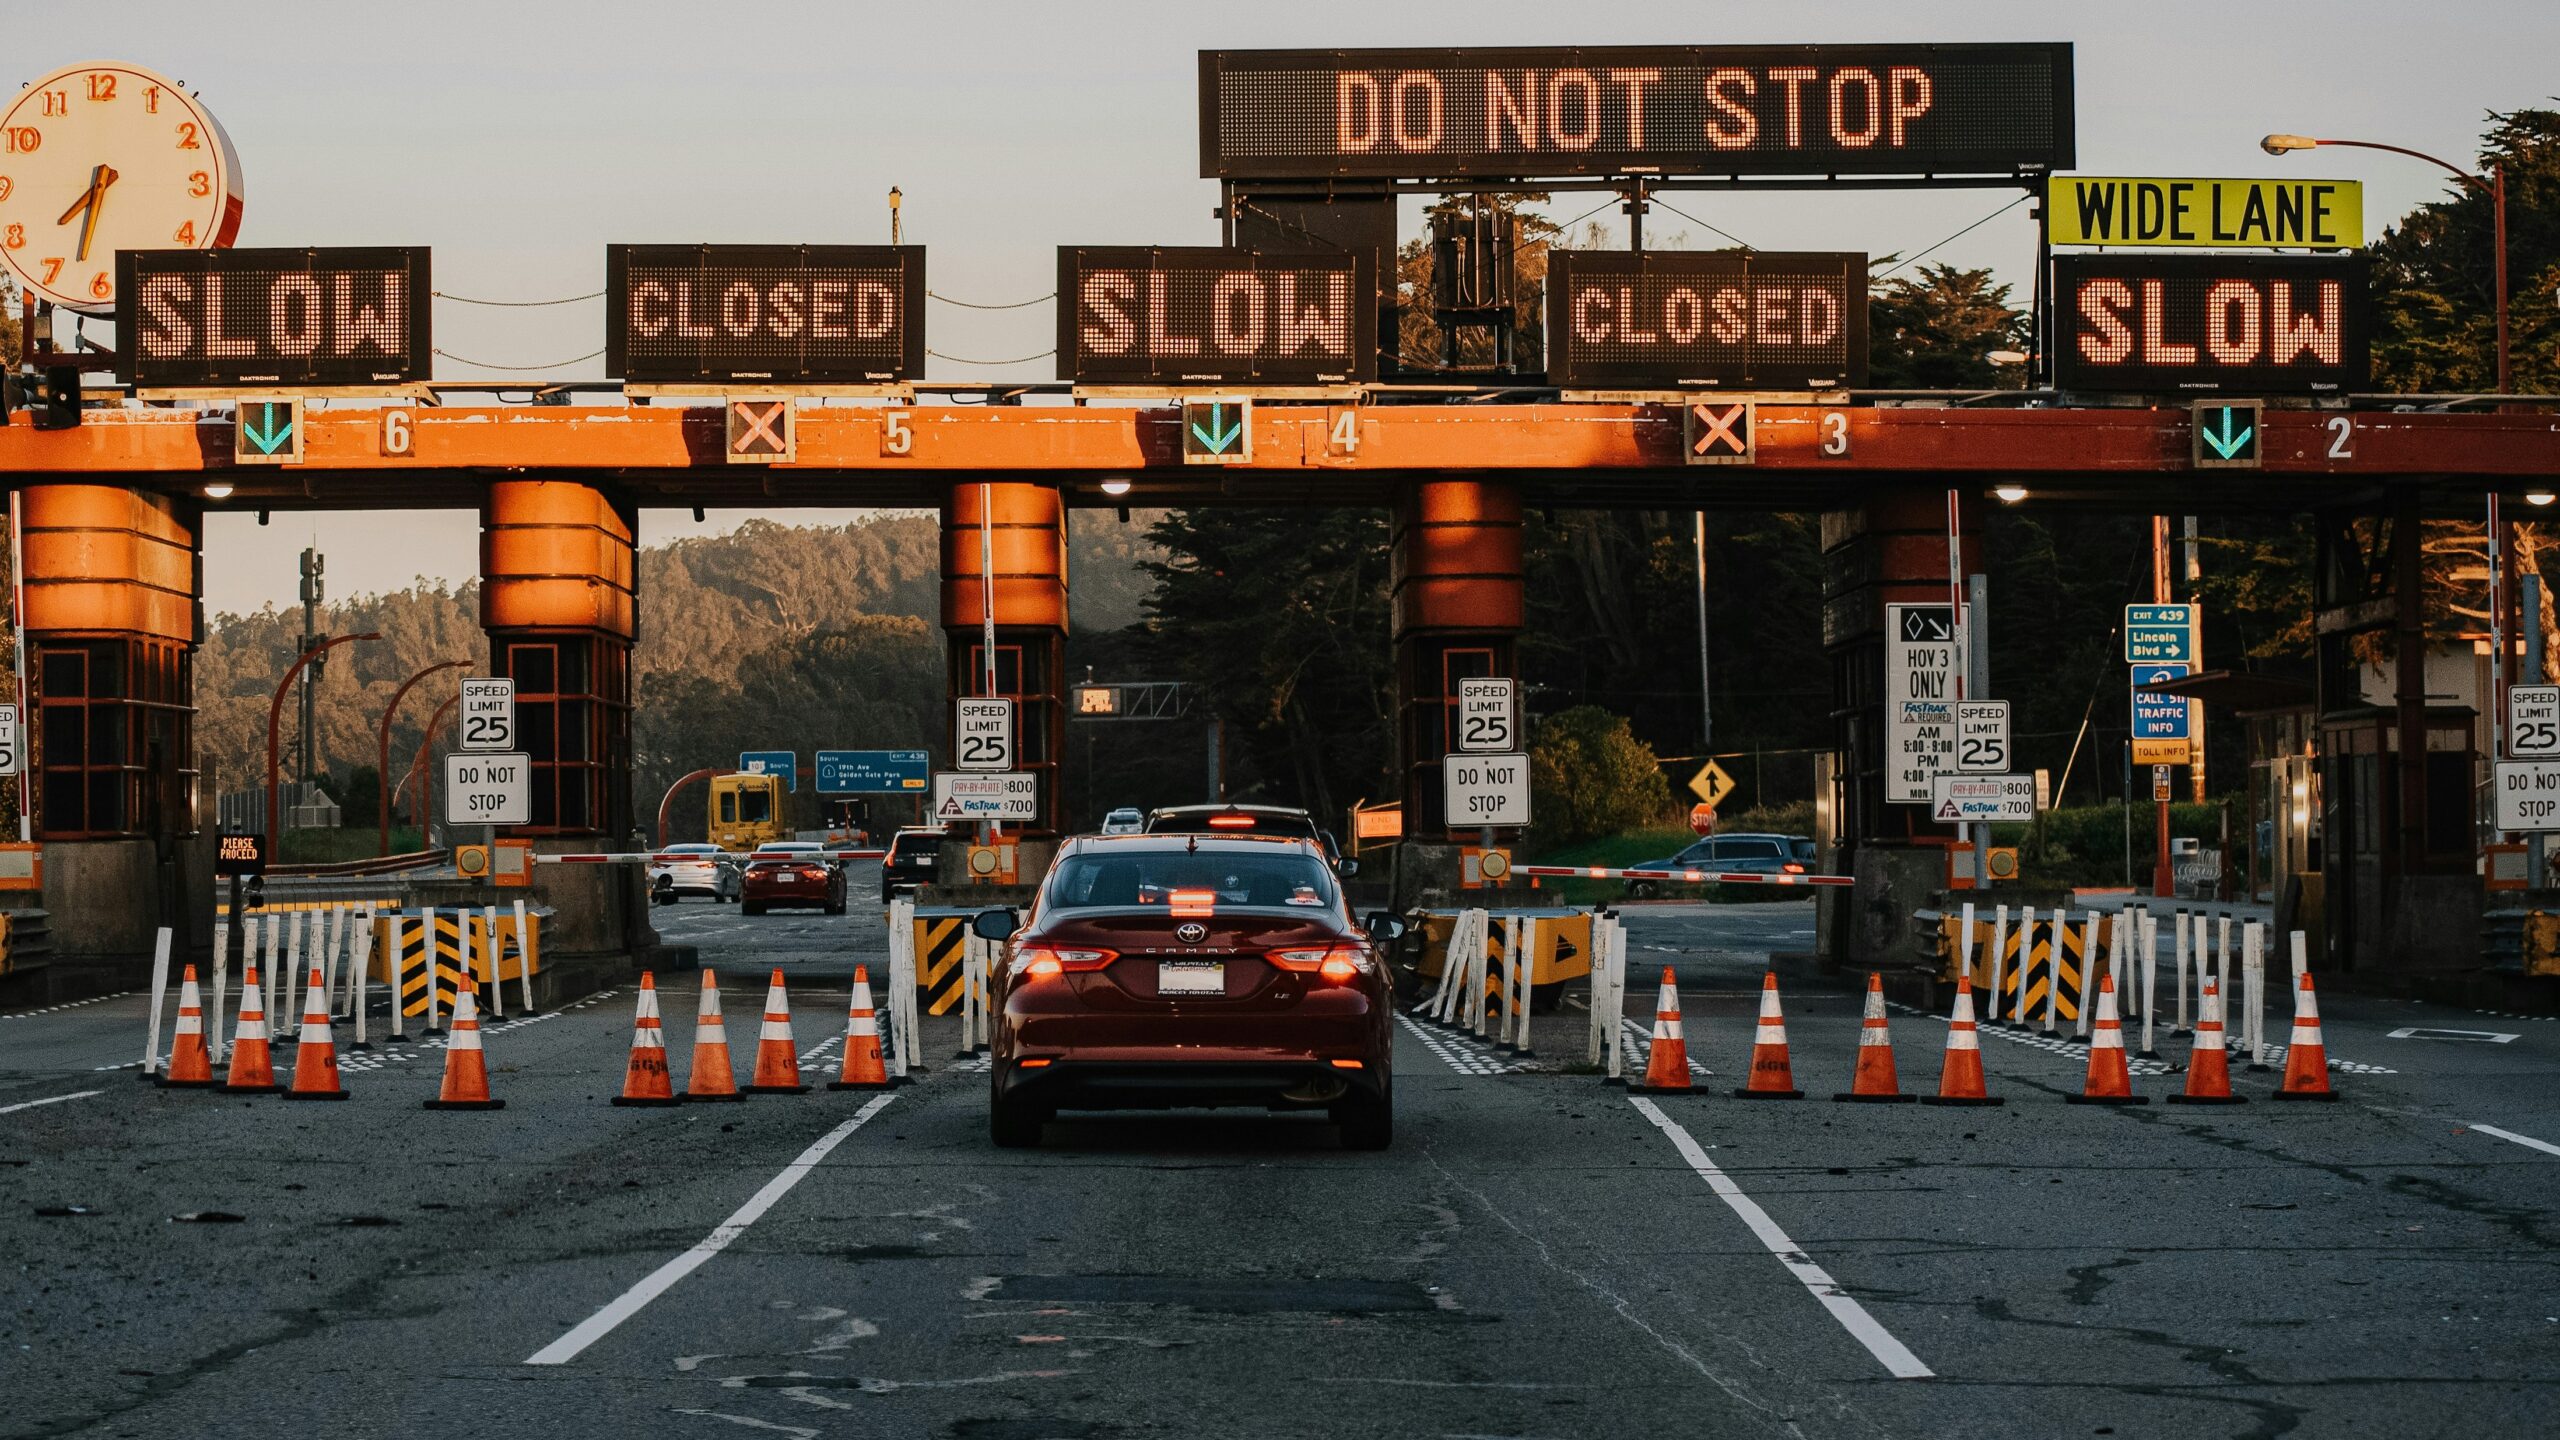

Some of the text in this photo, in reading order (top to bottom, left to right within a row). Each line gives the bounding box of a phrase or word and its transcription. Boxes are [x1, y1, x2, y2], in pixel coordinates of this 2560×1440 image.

[84, 74, 117, 102] 12
[40, 91, 68, 117] 11
[142, 86, 160, 114] 1
[1337, 66, 1932, 153] DO NOT STOP
[4, 127, 42, 153] 10
[176, 122, 200, 149] 2
[189, 171, 212, 198] 3
[2076, 182, 2336, 243] WIDE LANE
[2, 222, 27, 249] 8
[174, 220, 196, 246] 4
[41, 257, 65, 285] 7
[89, 272, 112, 299] 6
[140, 272, 400, 357] SLOW
[632, 281, 895, 338] CLOSED
[1083, 272, 1345, 355] SLOW
[1575, 287, 1837, 345] CLOSED
[2077, 280, 2341, 364] SLOW
[386, 410, 409, 453] 6
[887, 411, 911, 453] 5
[1332, 411, 1359, 452] 4
[1824, 412, 1847, 455] 3
[2327, 417, 2352, 458] 2
[2158, 611, 2185, 621] 439
[2133, 632, 2177, 642] Lincoln
[1908, 649, 1948, 668] HOV 3
[2133, 646, 2160, 656] Blvd
[466, 686, 509, 696] SPEED
[1464, 686, 1508, 697] SPEED
[1910, 671, 1946, 699] ONLY
[469, 701, 504, 711] LIMIT
[2136, 694, 2164, 704] CALL
[2513, 693, 2557, 703] SPEED
[963, 706, 1006, 717] SPEED
[1468, 702, 1503, 712] LIMIT
[1961, 708, 2004, 719] SPEED
[2138, 708, 2183, 718] TRAFFIC
[2518, 708, 2552, 718] LIMIT
[967, 721, 1002, 731] LIMIT
[1918, 713, 1952, 722] REQUIRED
[466, 717, 509, 743] 25
[1465, 717, 1508, 743] 25
[1917, 727, 1940, 739] AM
[1965, 724, 2000, 734] LIMIT
[2148, 723, 2173, 732] INFO
[2515, 723, 2557, 749] 25
[963, 737, 1006, 762] 25
[1904, 740, 1924, 753] 5:00
[1932, 740, 1952, 753] 9:00
[1961, 739, 2004, 765] 25
[2138, 747, 2185, 756] TOLL INFO
[1917, 755, 1939, 767] PM
[459, 767, 516, 784] DO NOT
[1458, 768, 1515, 785] DO NOT
[1903, 770, 1924, 782] 4:00
[2508, 775, 2528, 790] DO
[954, 783, 1000, 793] PAY-BY-PLATE
[1910, 790, 1928, 798] MON
[1953, 784, 1999, 794] PAY-BY-PLATE
[469, 794, 506, 811] STOP
[1469, 796, 1506, 812] STOP
[2519, 800, 2556, 817] STOP
[223, 837, 253, 848] PLEASE
[220, 849, 257, 860] PROCEED
